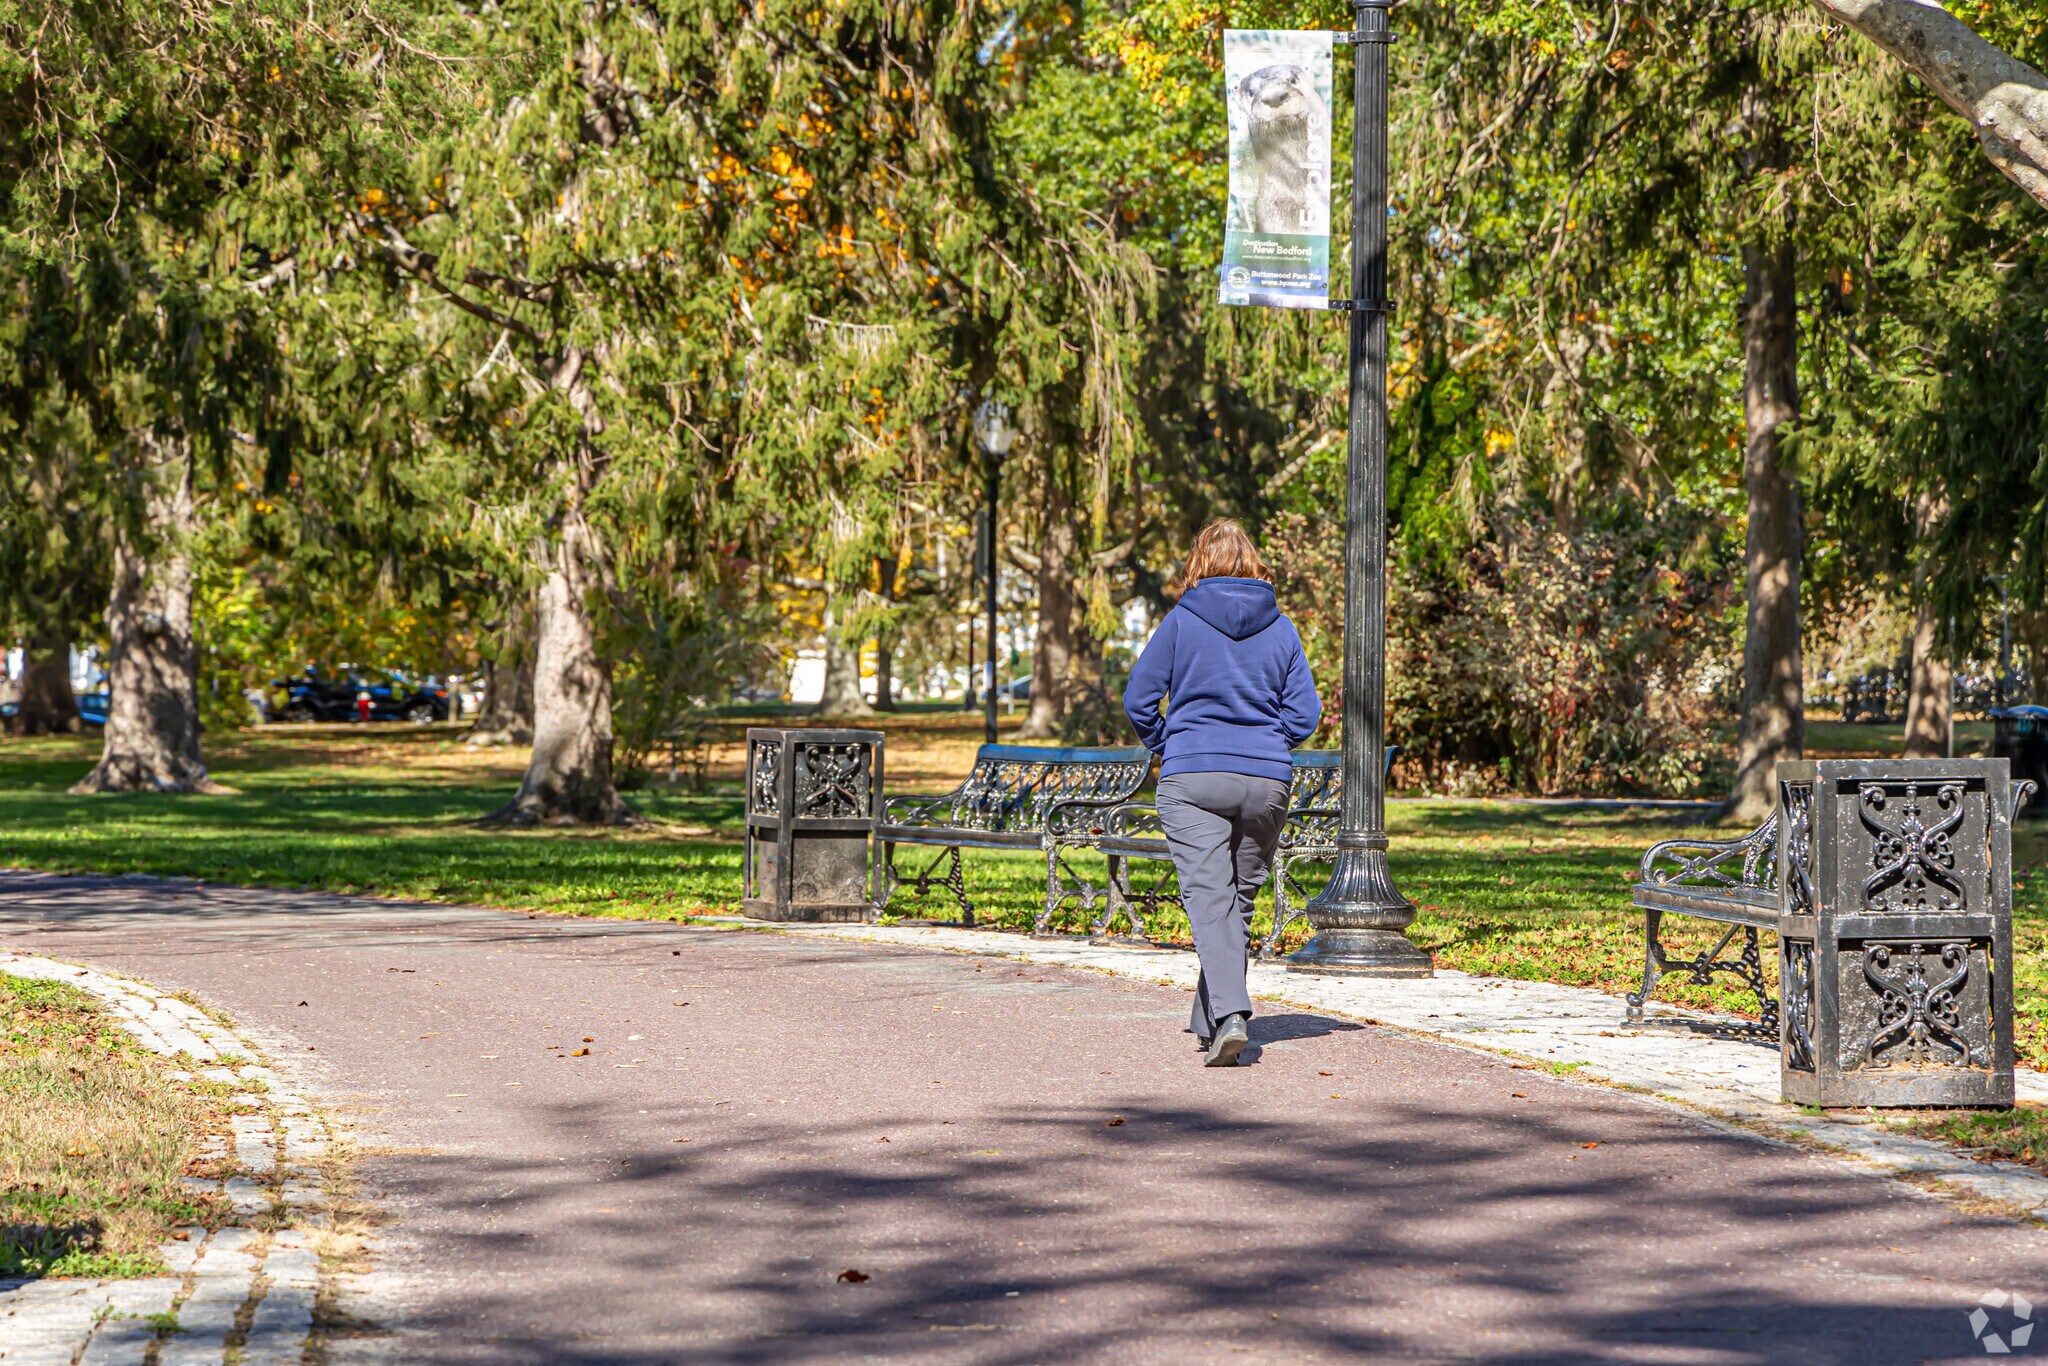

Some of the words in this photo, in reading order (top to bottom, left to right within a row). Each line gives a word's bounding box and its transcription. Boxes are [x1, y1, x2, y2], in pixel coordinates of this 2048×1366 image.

[1299, 111, 1323, 227] Eplore
[1242, 239, 1279, 247] Destination
[1253, 245, 1274, 254] New
[1276, 246, 1313, 255] Bedford
[1251, 271, 1291, 279] Buttonwood
[1309, 273, 1322, 281] Zoo
